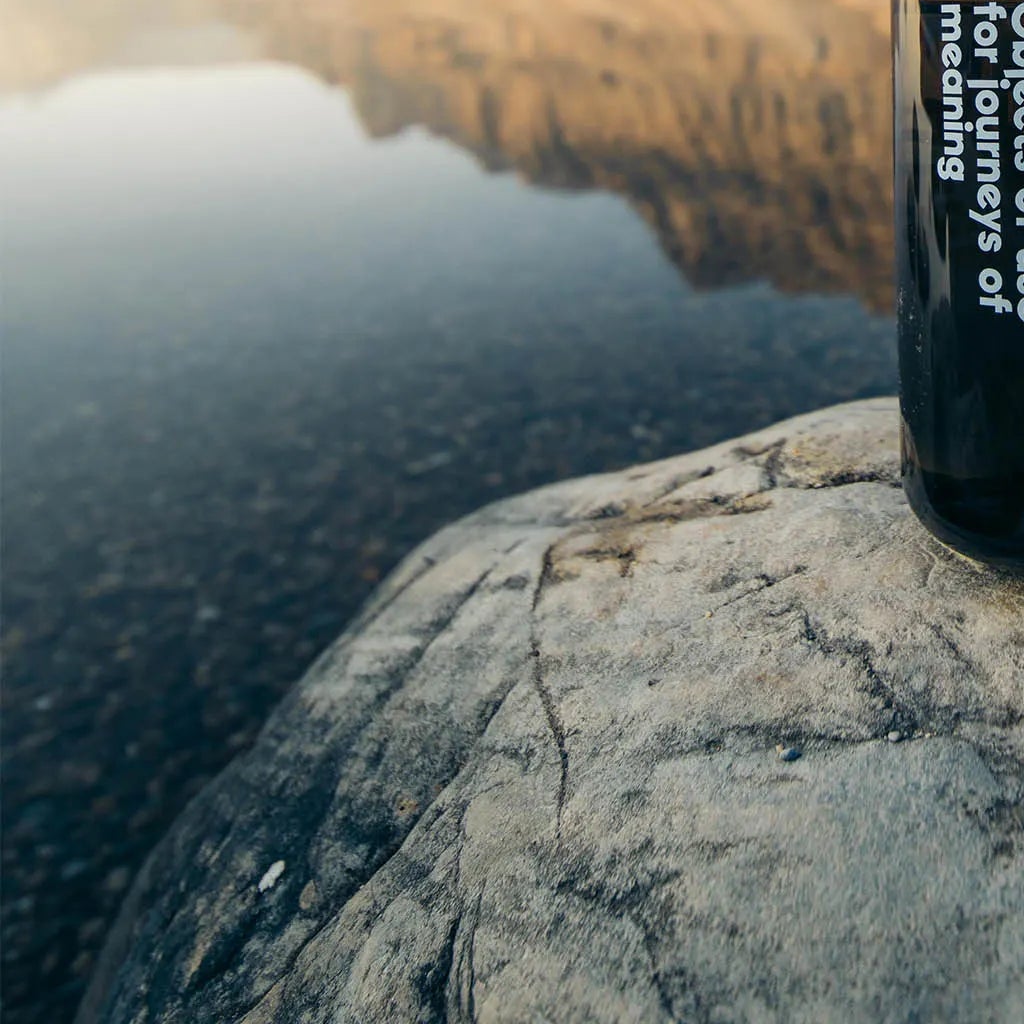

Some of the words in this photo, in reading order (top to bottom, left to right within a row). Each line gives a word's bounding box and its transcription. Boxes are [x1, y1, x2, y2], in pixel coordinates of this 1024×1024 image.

[973, 1, 1007, 64] for
[936, 4, 974, 182] meaning
[966, 79, 1011, 253] journeys
[978, 267, 1013, 314] of
